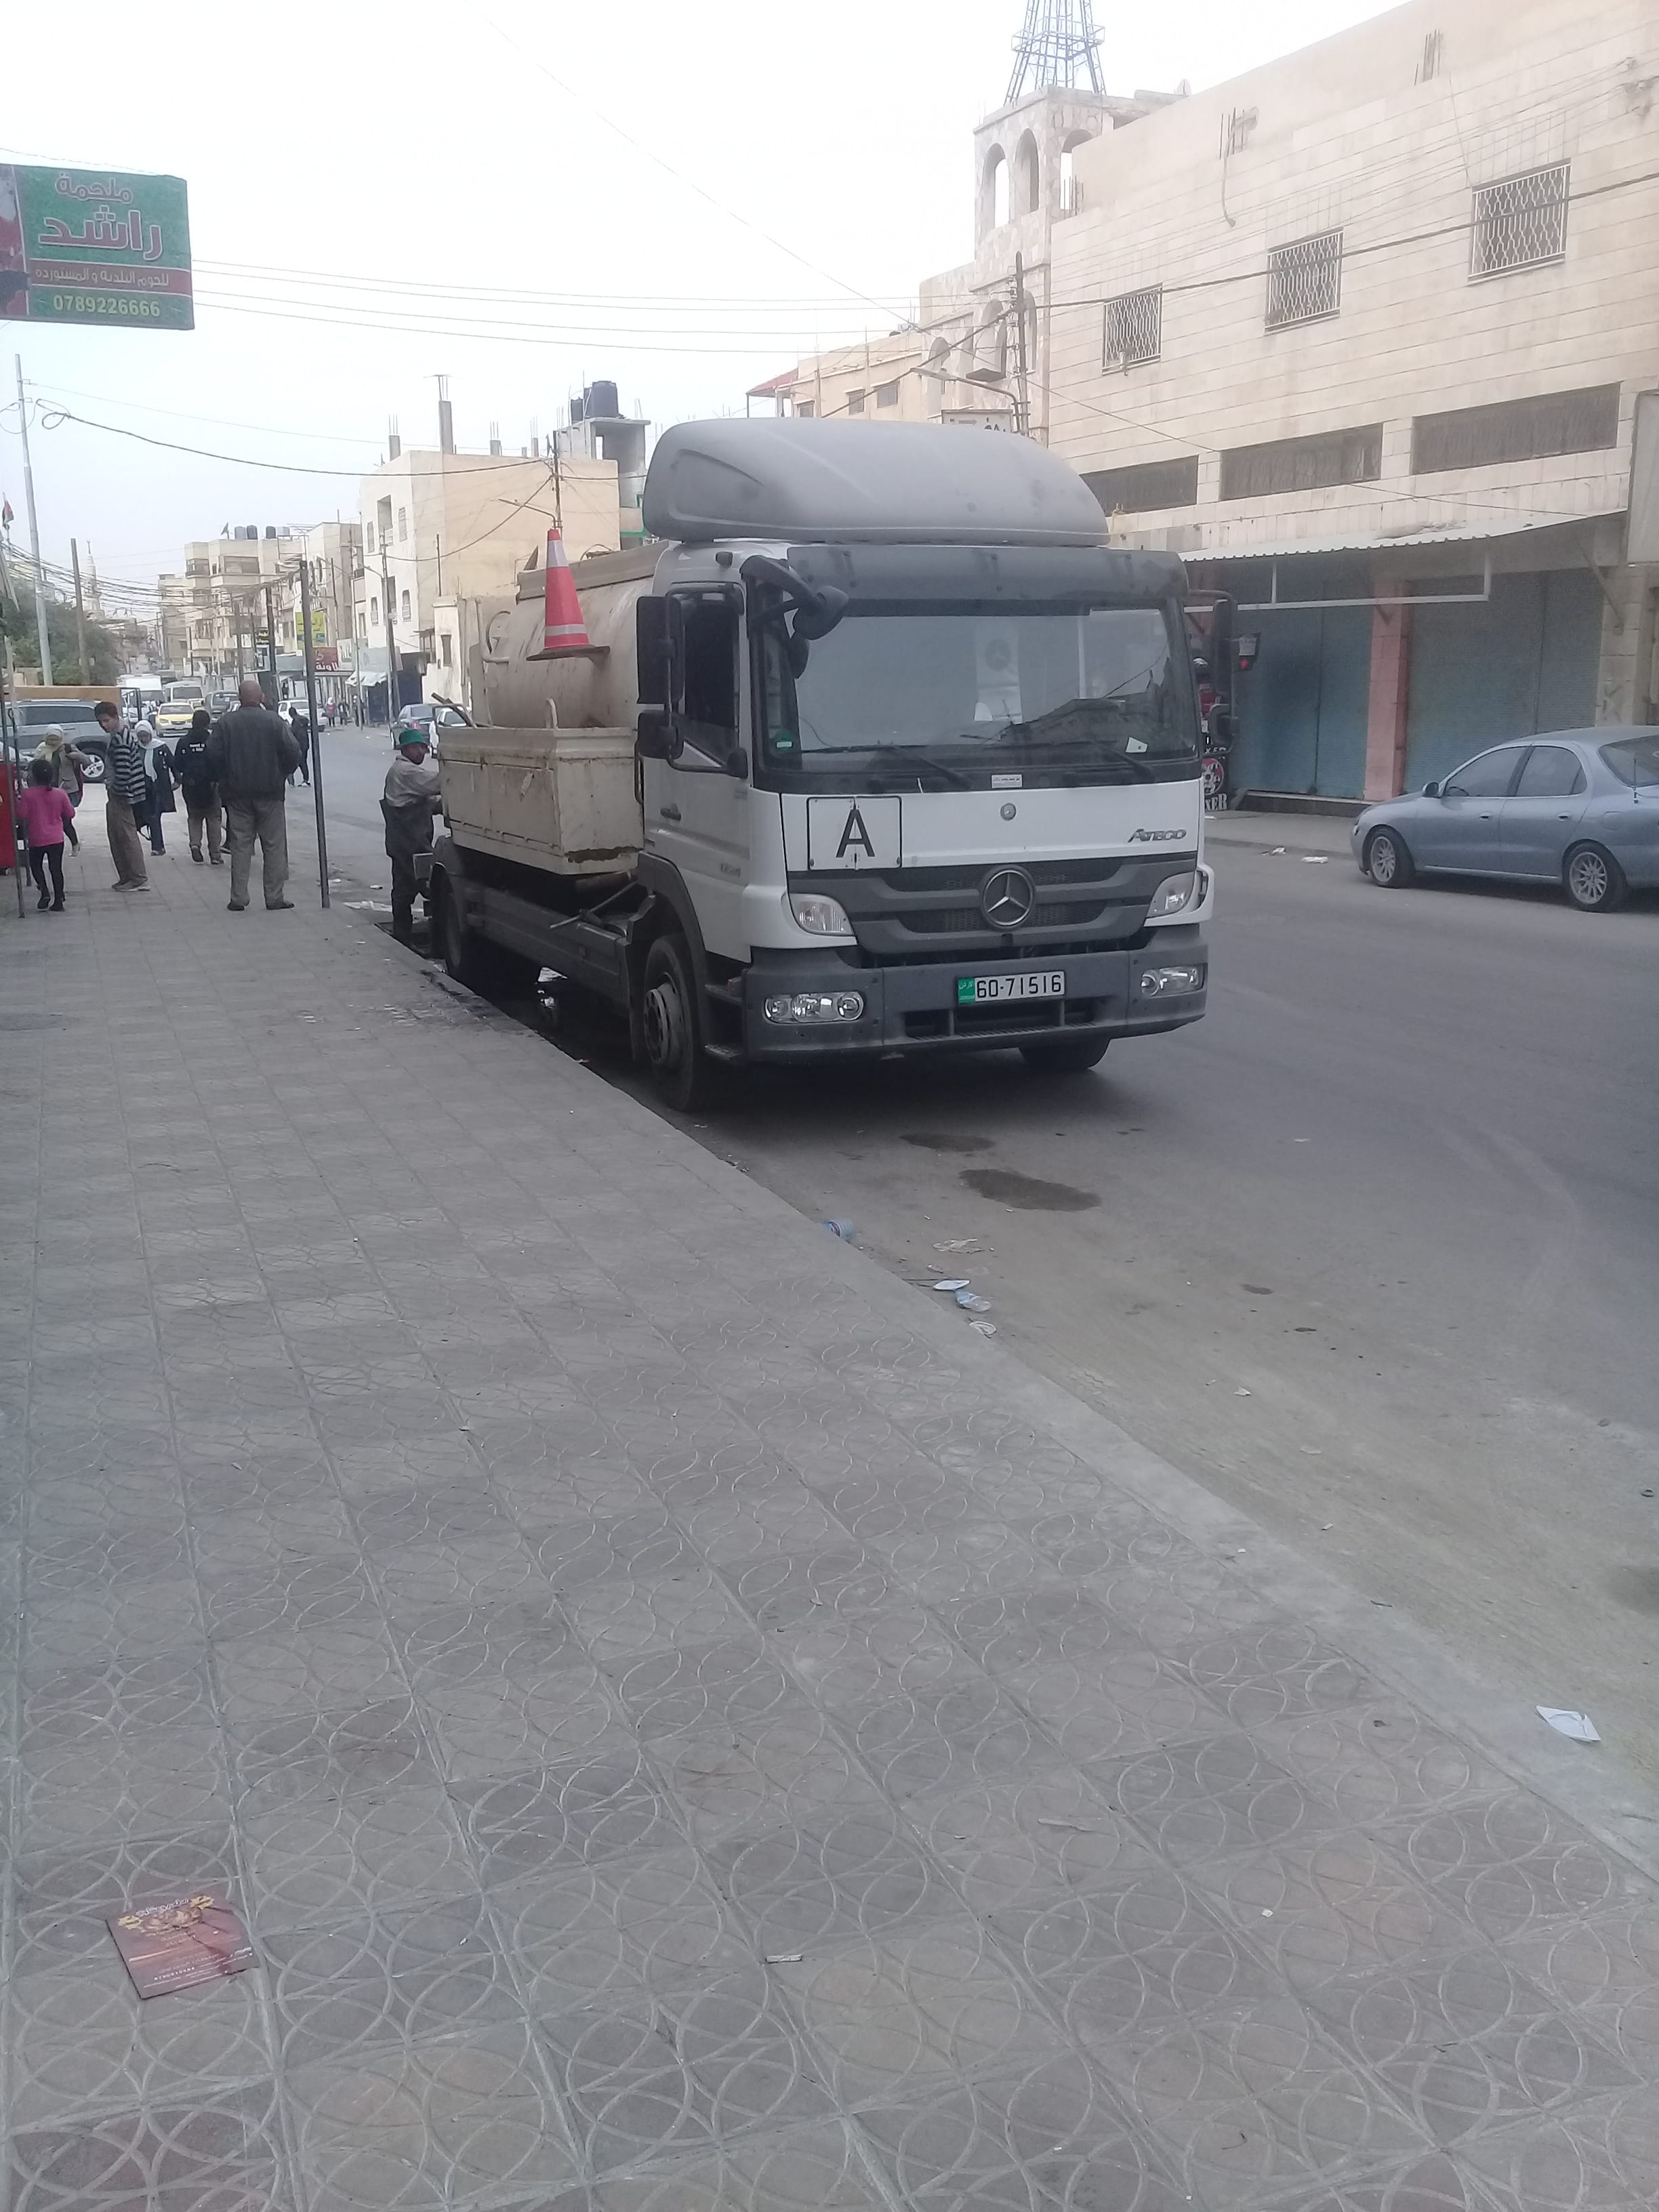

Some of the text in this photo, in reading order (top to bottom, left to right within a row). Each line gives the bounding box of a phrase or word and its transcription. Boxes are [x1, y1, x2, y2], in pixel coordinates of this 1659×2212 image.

[56, 173, 132, 203] ملحمة
[39, 205, 162, 260] راشد
[91, 272, 98, 284] و
[138, 272, 169, 287] للحوم
[54, 295, 160, 316] 0789226666
[836, 809, 876, 858] A
[977, 975, 1061, 998] 60-71516
